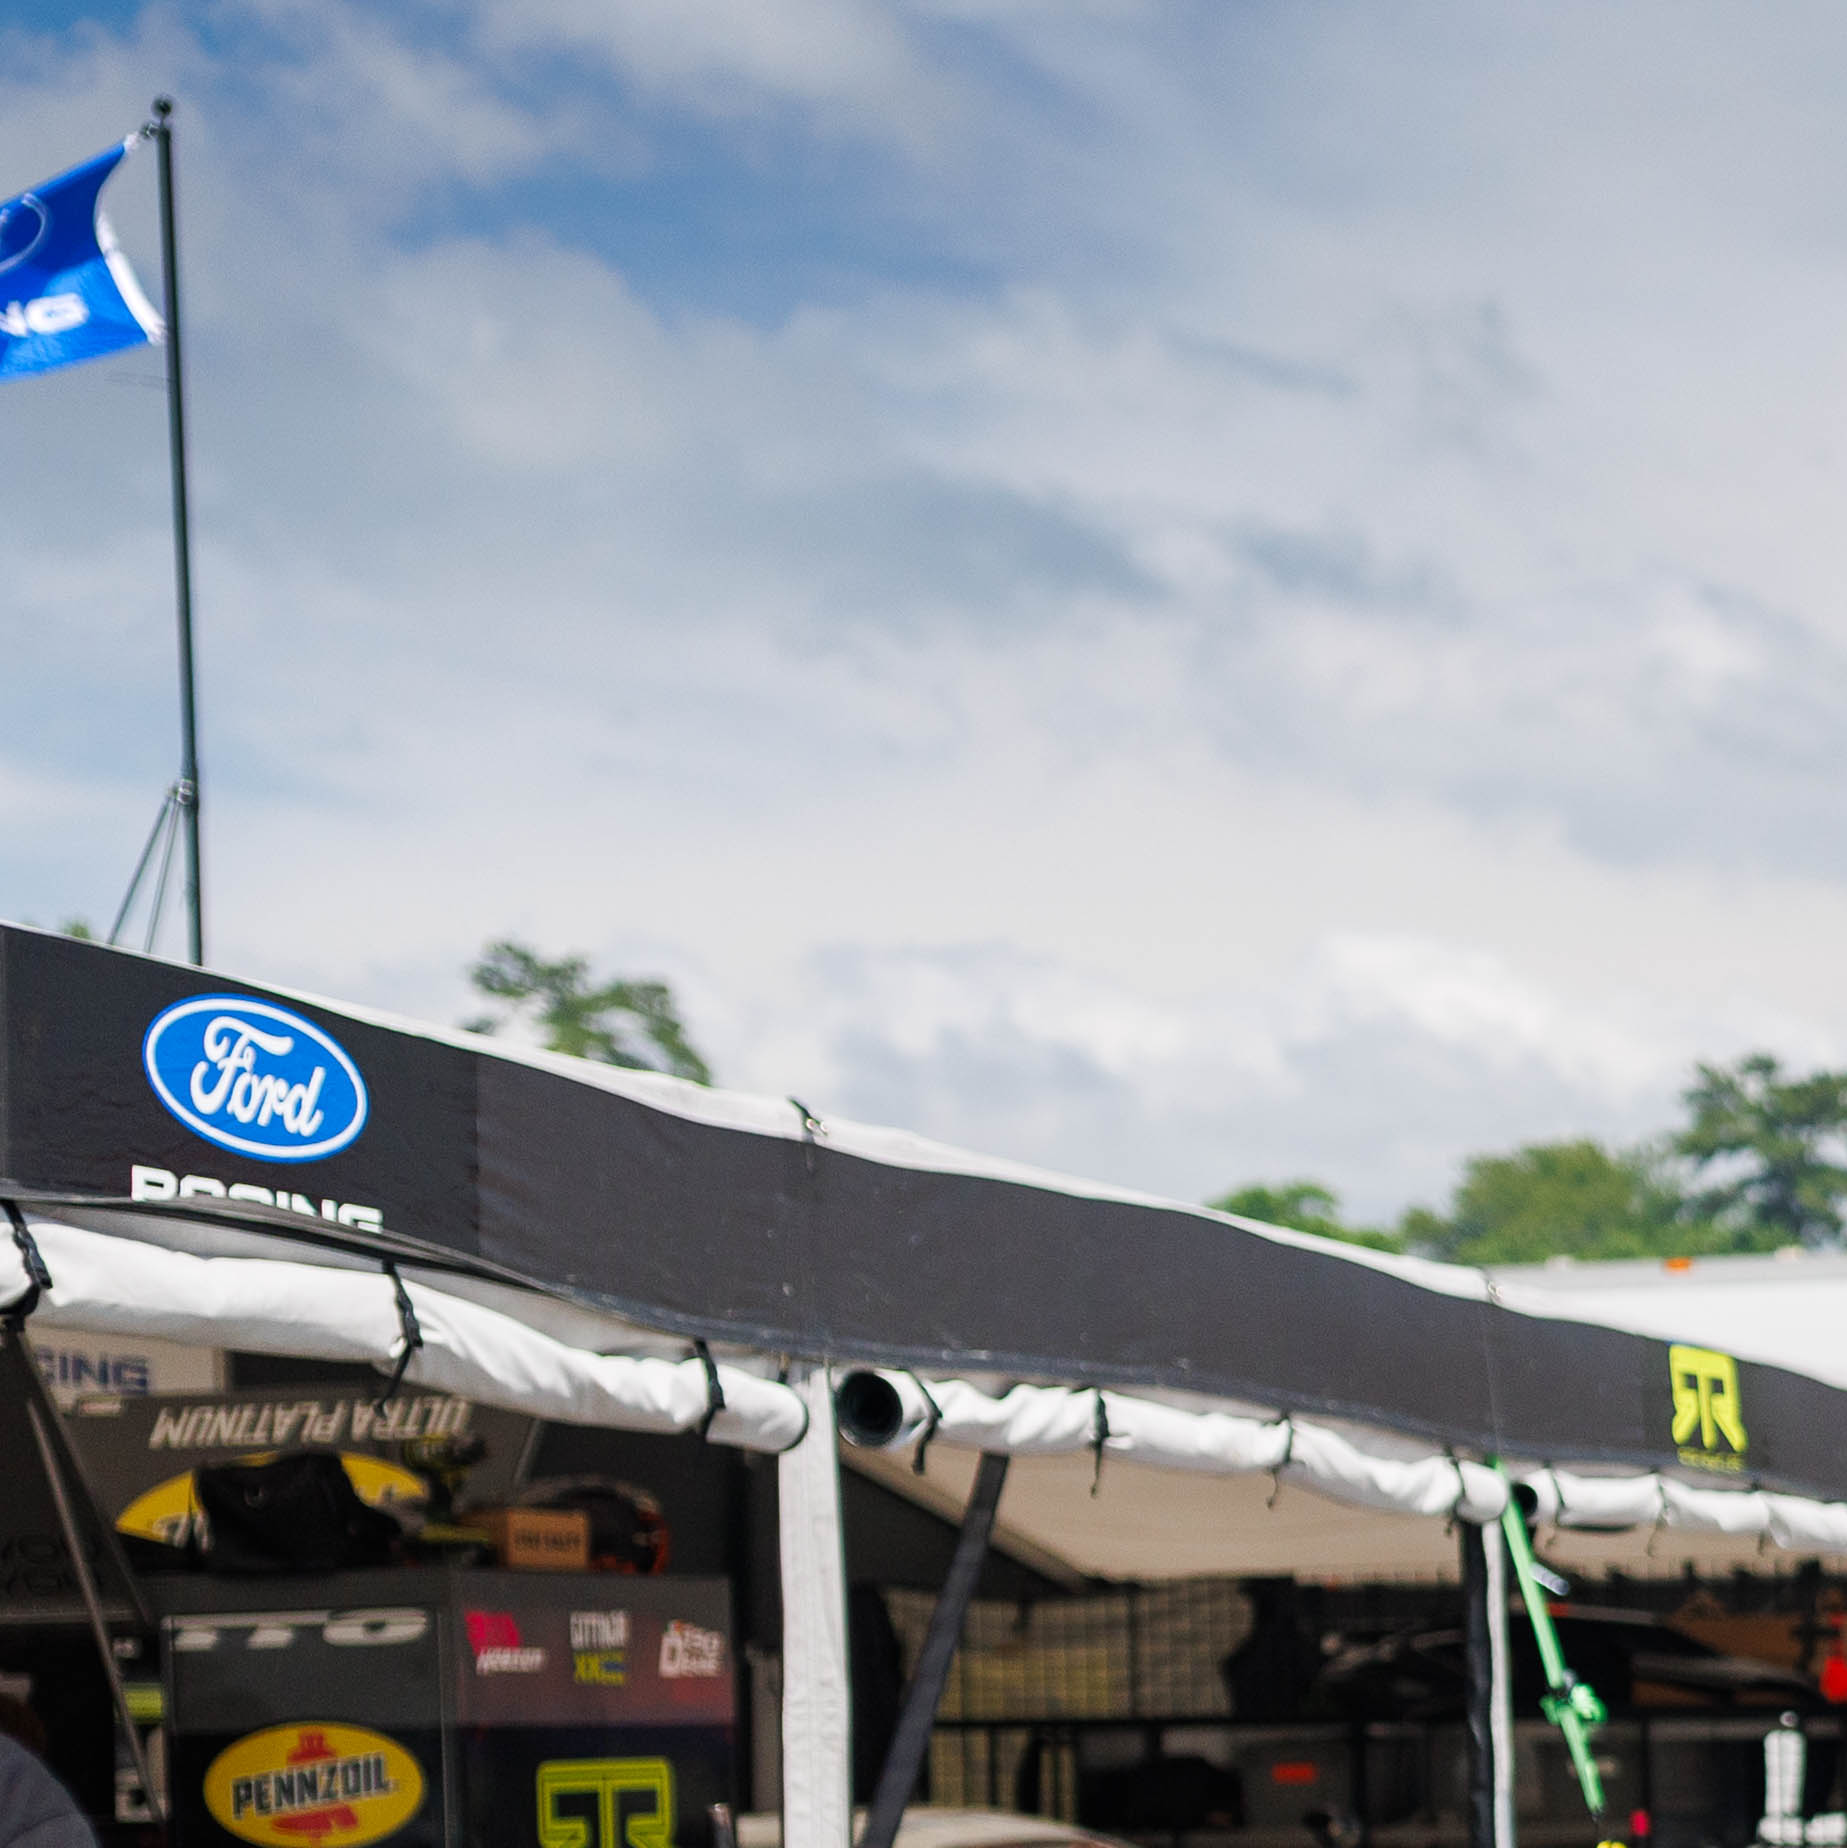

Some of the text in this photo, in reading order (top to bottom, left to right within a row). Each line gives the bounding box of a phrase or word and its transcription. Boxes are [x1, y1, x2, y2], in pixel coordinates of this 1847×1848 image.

[190, 1015, 327, 1137] Ford
[149, 1402, 347, 1450] PLATINUM
[232, 1752, 389, 1822] PENNZOIL
